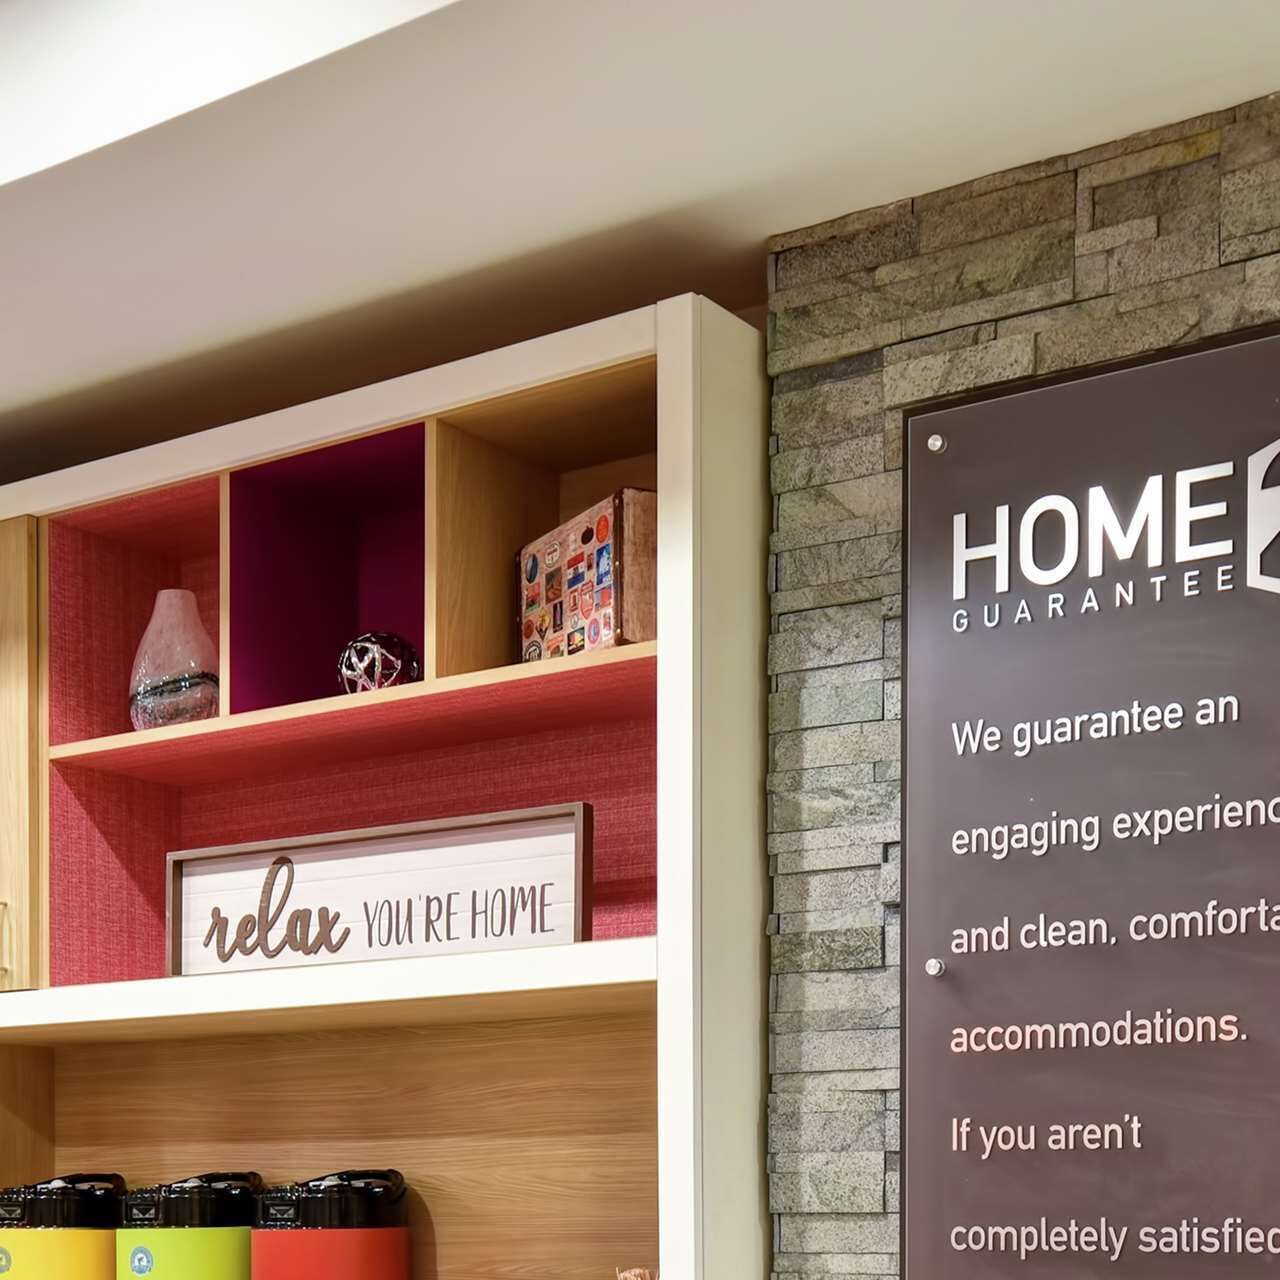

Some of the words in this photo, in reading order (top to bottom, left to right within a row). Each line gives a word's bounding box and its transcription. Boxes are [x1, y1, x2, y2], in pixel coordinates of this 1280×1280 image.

[952, 460, 1234, 601] HOME
[952, 565, 1235, 633] GUARANTEE
[951, 719, 1002, 756] We
[1013, 699, 1184, 757] guarantee
[1195, 695, 1239, 726] an
[951, 811, 1100, 860] engaging
[202, 855, 351, 963] relax
[363, 891, 461, 948] YOU'RE
[471, 882, 556, 939] HOME
[951, 917, 1010, 954] and
[1020, 914, 1118, 948] clean,
[950, 1008, 1248, 1053] accommodations.
[951, 1117, 972, 1152] If
[979, 1123, 1036, 1160] you
[1047, 1114, 1143, 1151] aren't
[950, 1217, 1128, 1261] completely
